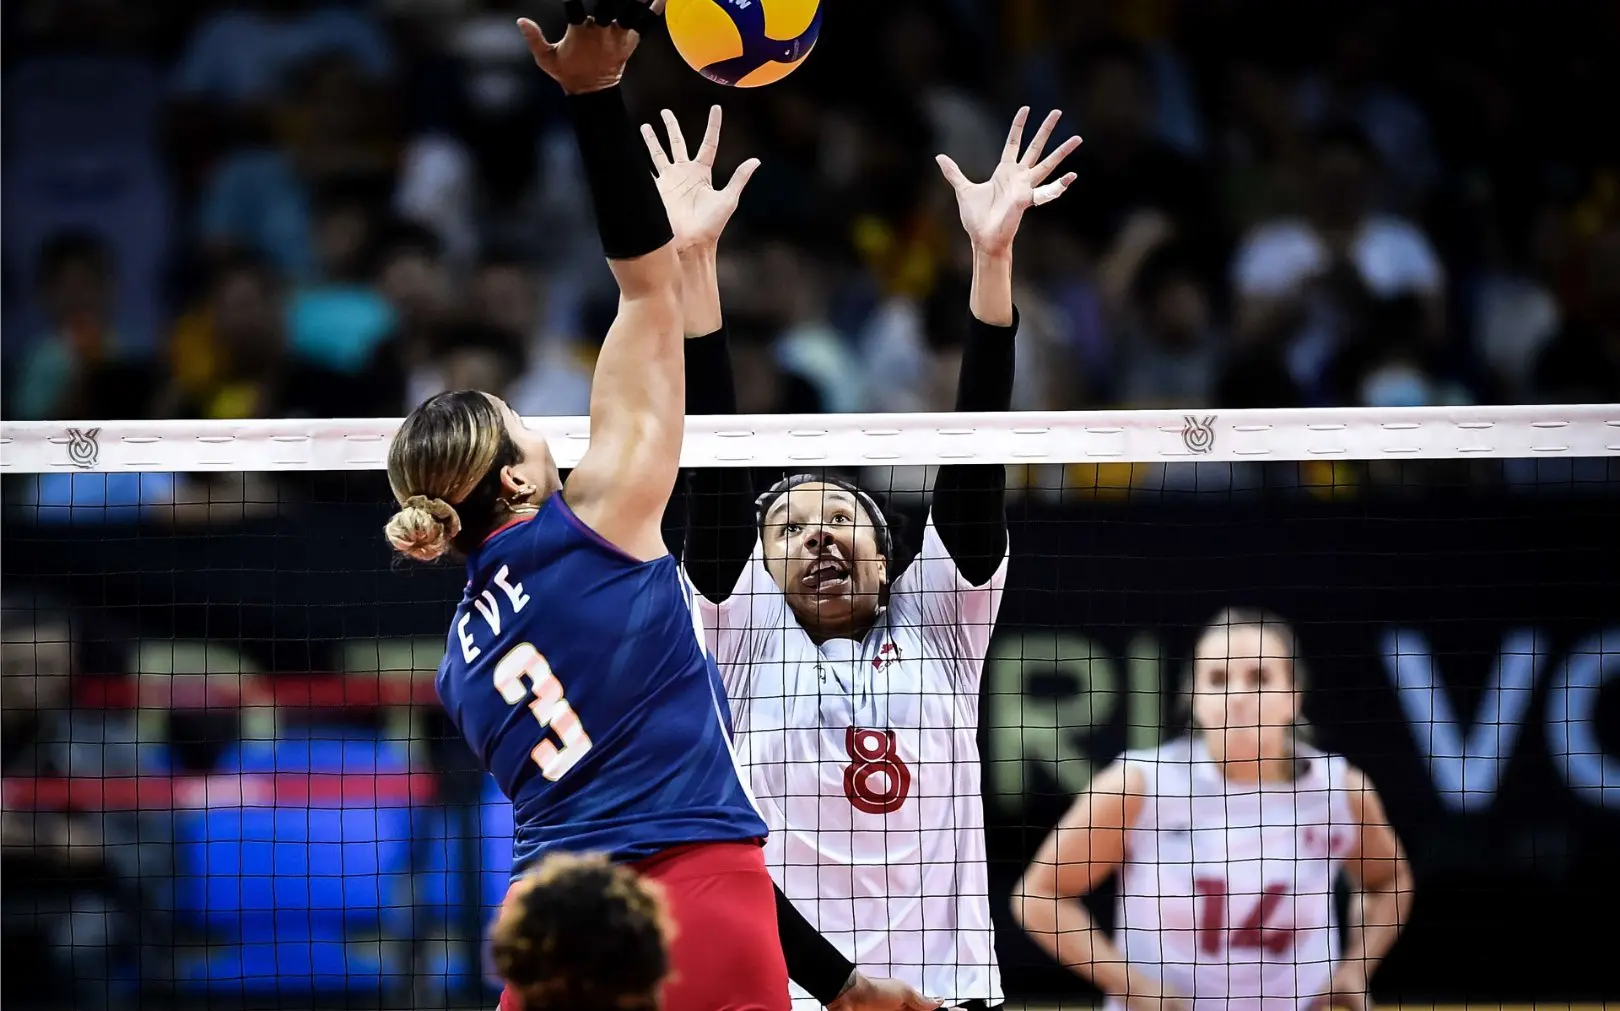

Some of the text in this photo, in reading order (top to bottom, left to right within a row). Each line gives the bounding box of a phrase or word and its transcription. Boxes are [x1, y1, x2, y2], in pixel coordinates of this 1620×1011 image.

[457, 564, 531, 664] EVE
[493, 641, 593, 782] 3
[843, 725, 911, 815] 8
[1194, 877, 1297, 956] 14
